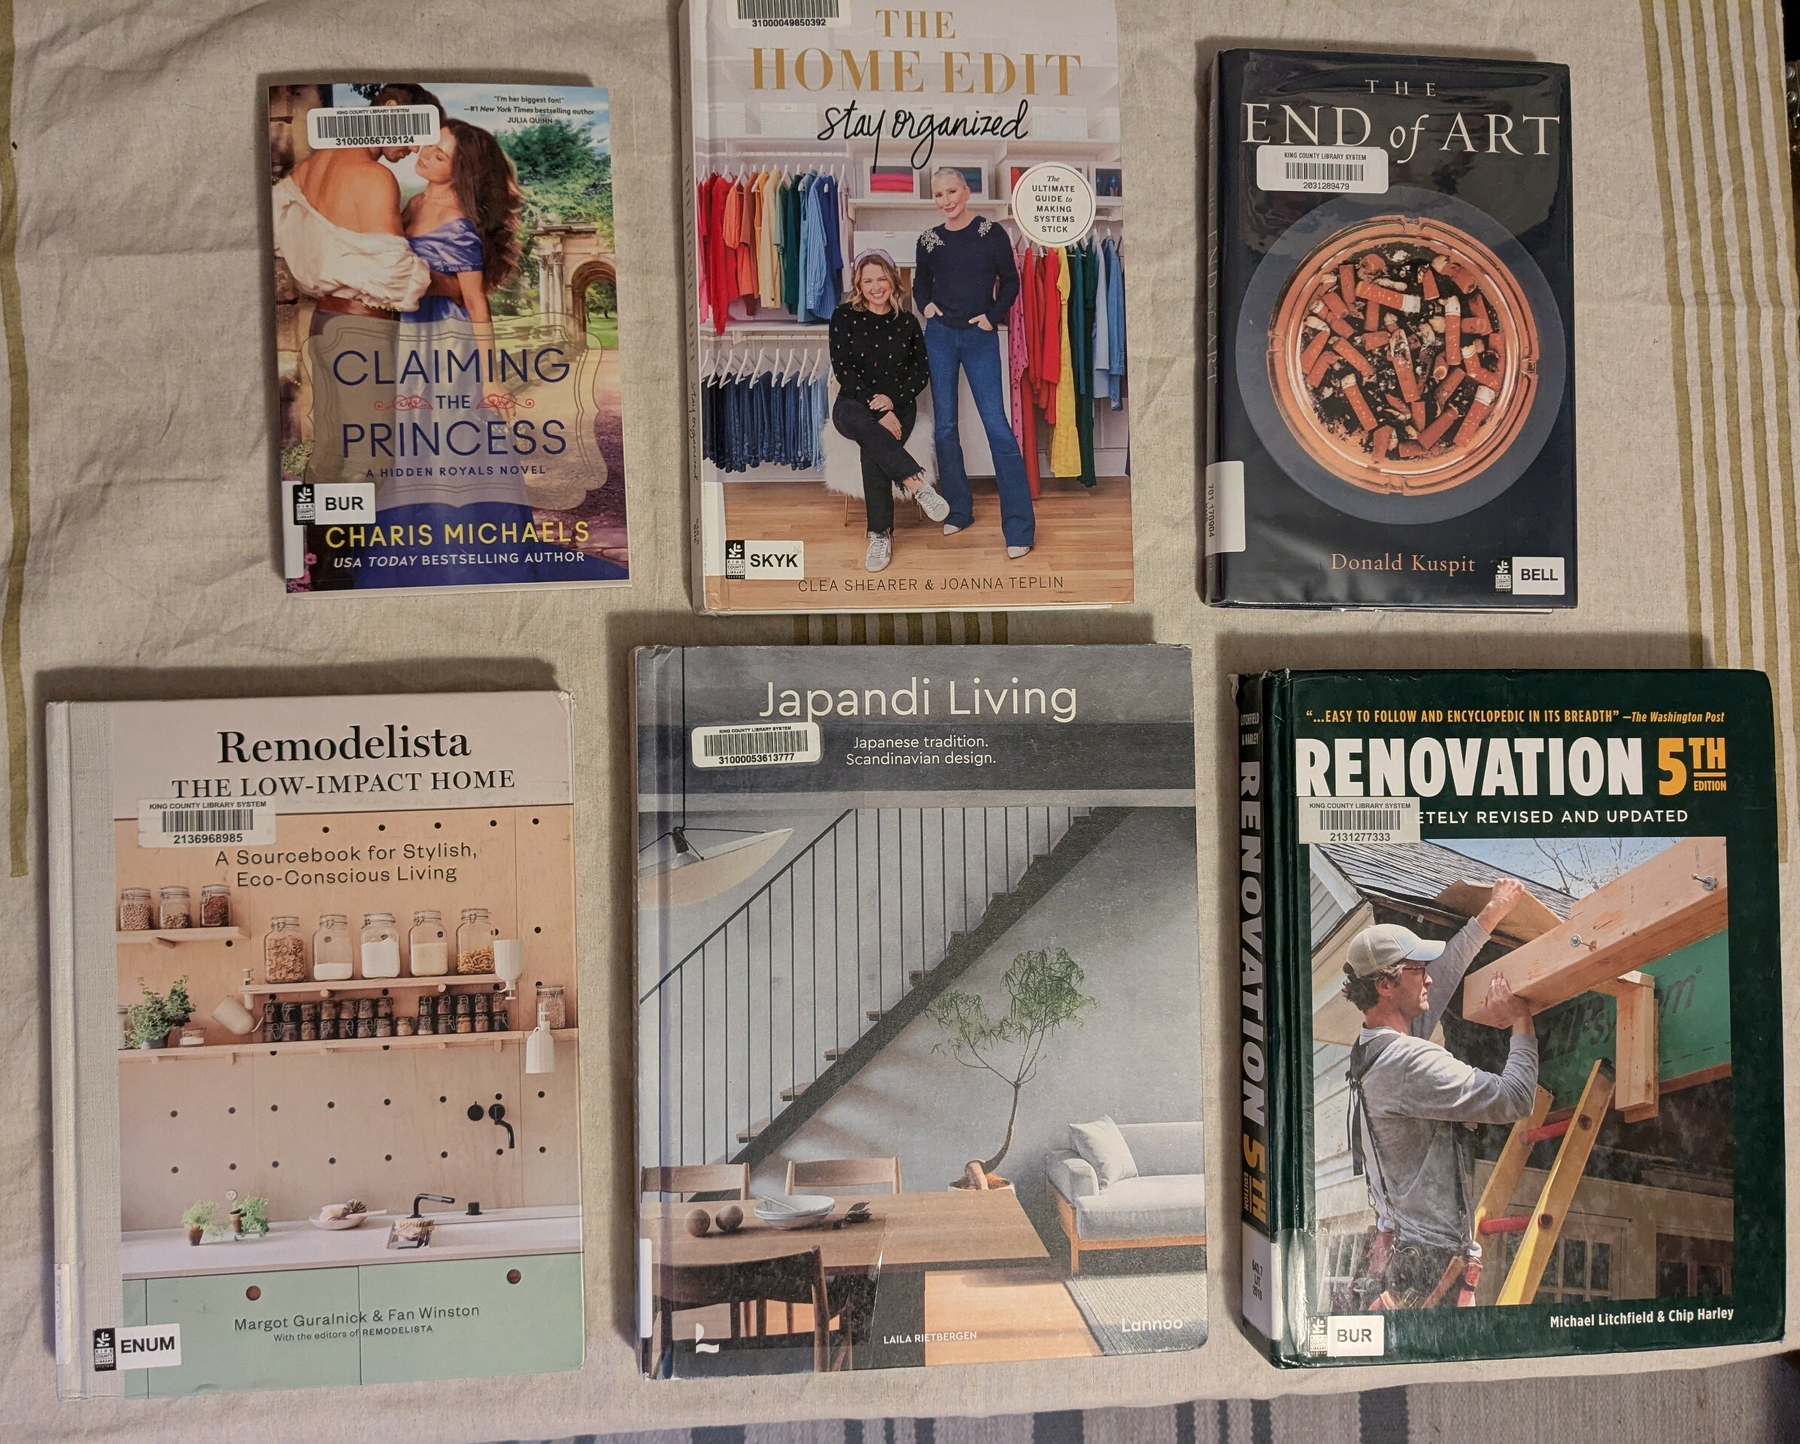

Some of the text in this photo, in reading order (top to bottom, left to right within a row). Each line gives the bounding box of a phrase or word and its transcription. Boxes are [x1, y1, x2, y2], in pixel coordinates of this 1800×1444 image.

[752, 19, 826, 27] 31000049850392
[876, 10, 956, 39] THE
[750, 48, 1082, 96] HOME EDIT
[1364, 79, 1437, 98] THE
[521, 96, 546, 104] biggest
[535, 108, 571, 116] bestselling
[336, 136, 415, 146] 31000056739124
[817, 99, 1029, 173] stay organized
[1241, 102, 1372, 147] END
[1389, 114, 1430, 164] of
[1440, 112, 1561, 156] ART
[1303, 182, 1350, 190] 2031289479
[333, 347, 570, 386] CLAIMING
[435, 395, 471, 409] THE
[343, 419, 567, 458] PRINCESS
[366, 465, 546, 478] A HIDDEN ROYALS NOVEL
[326, 497, 364, 511] BUR
[326, 521, 590, 549] CHARIS MICHAELS
[334, 551, 585, 568] USA TODAY BESTSELLING AUTHOR
[750, 554, 798, 568] SKYK
[1331, 553, 1476, 578] Donald Kuspit
[1521, 569, 1559, 581] BELL
[798, 576, 1064, 593] CLEA SHEARER & JOANNA TEPLIN
[759, 677, 1077, 723] Japandi Living
[1357, 710, 1370, 723] TO
[1375, 710, 1417, 723] FOLLOW
[1421, 710, 1444, 723] AND
[1448, 710, 1525, 723] ENCYCLOPEDIC
[1529, 710, 1540, 723] IN
[1544, 710, 1561, 723] ITS
[1650, 711, 1703, 724] Washington
[1705, 712, 1725, 723] Post
[217, 724, 471, 764] Remodelista
[853, 735, 989, 751] Japanese tradition.
[719, 753, 795, 765] 31000053613777
[846, 751, 997, 768] Scandinavian design.
[1296, 736, 1726, 797] RENOVATION 5TH
[172, 769, 516, 799] THE LOW-IMPACT HOME
[1694, 780, 1727, 791] EDITION
[1477, 810, 1557, 824] REVISED
[1562, 810, 1601, 824] AND
[1607, 810, 1688, 823] UPDATED
[174, 833, 243, 844] 2136968985
[1330, 833, 1391, 842] 2131277333
[216, 842, 478, 866] A Sourcebook for Stylish,
[237, 864, 457, 888] Eco-Conscious Living
[1241, 761, 1267, 1224] RENOVATION 5TH
[234, 1306, 480, 1333] Margot Guralnick & Fan Winston
[1122, 1317, 1184, 1333] Lannoo
[1550, 1307, 1734, 1328] Michael Litchfield & Chip Harley
[274, 1325, 433, 1342] With the editors of REMODELISTA
[884, 1331, 977, 1344] LAILA RIETBERGEN
[1337, 1329, 1372, 1343] BUR
[121, 1336, 175, 1354] ENUM
